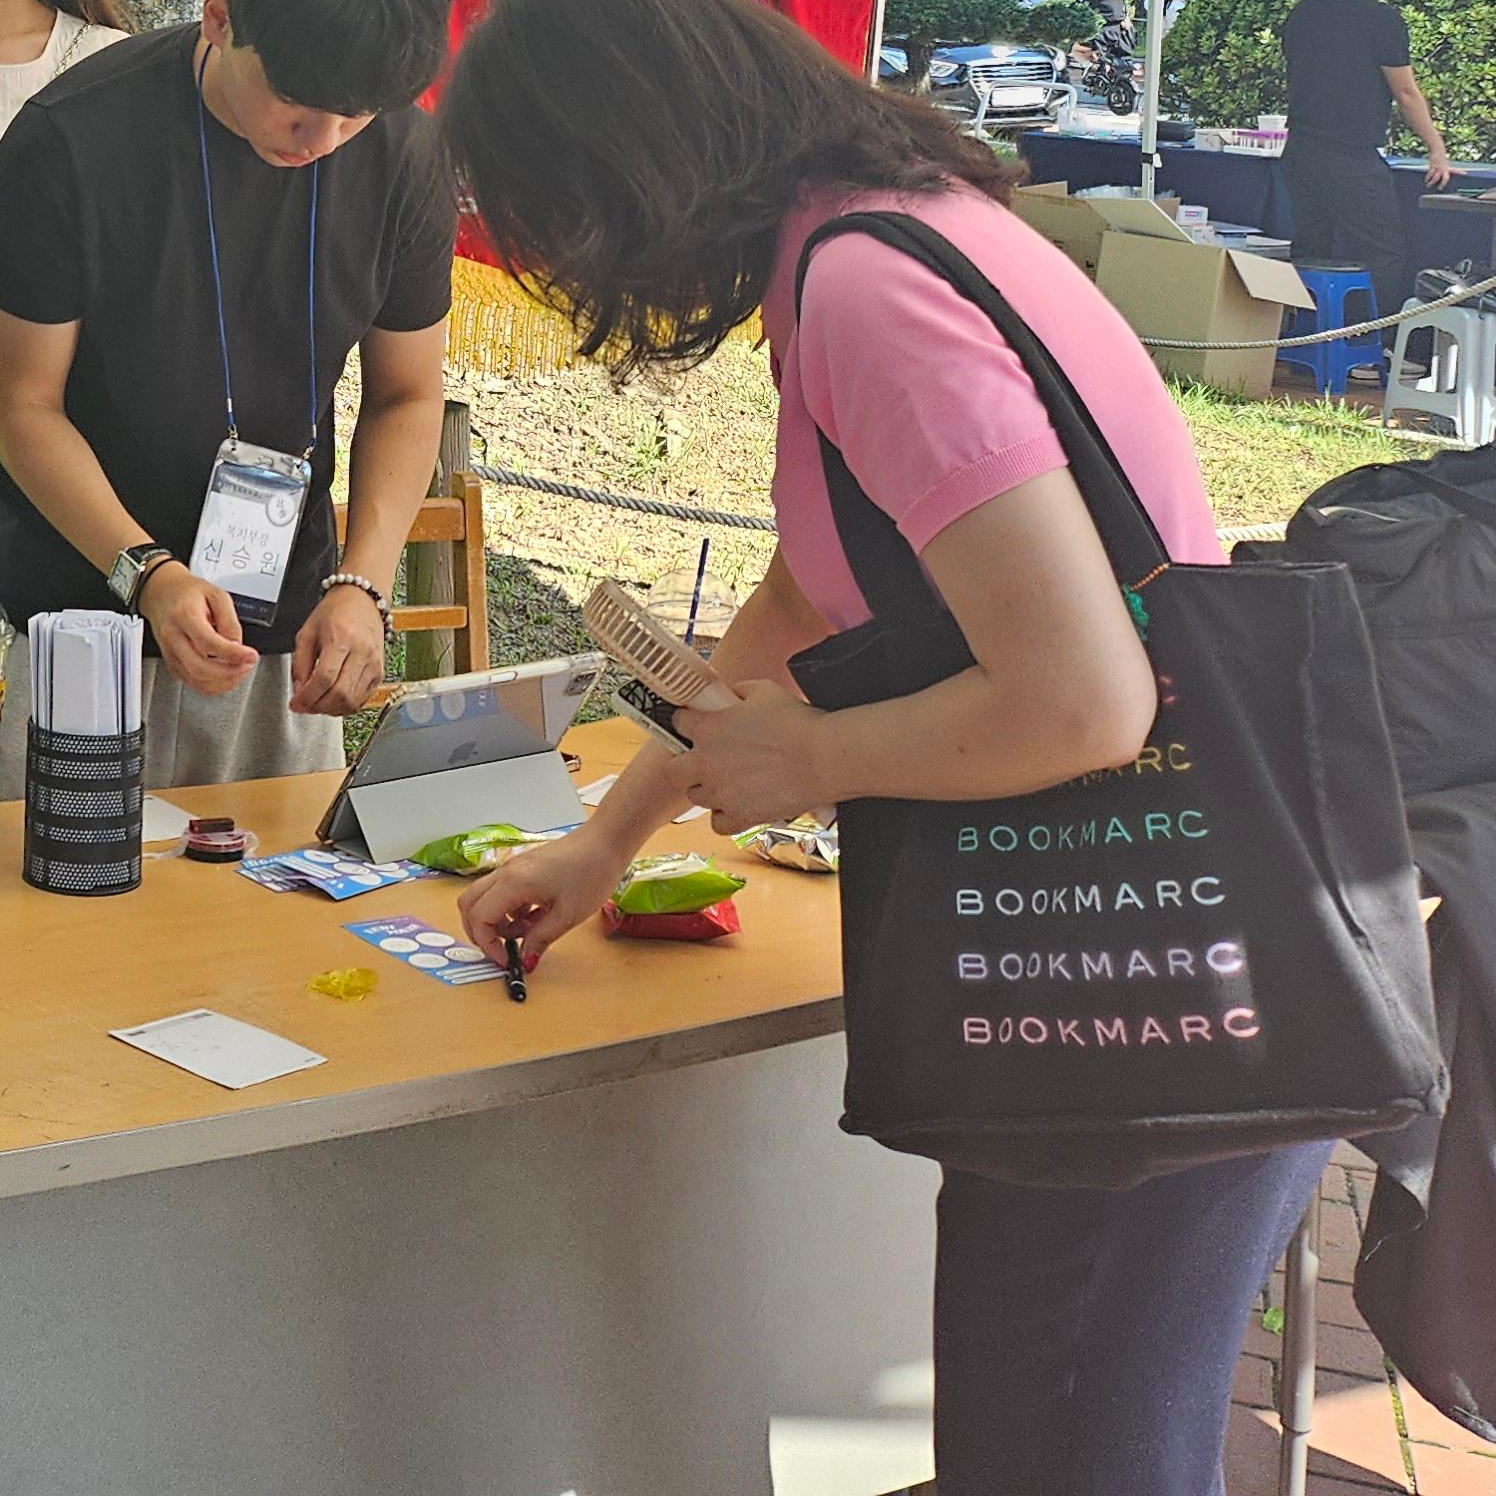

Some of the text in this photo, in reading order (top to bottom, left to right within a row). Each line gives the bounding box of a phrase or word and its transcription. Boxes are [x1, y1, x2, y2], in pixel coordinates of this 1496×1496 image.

[957, 809, 1209, 852] BOOKMARC
[955, 876, 1226, 916] BOOKMARC
[957, 941, 1246, 981] BOOKMARC
[962, 1007, 1261, 1047] BOOKMARC
